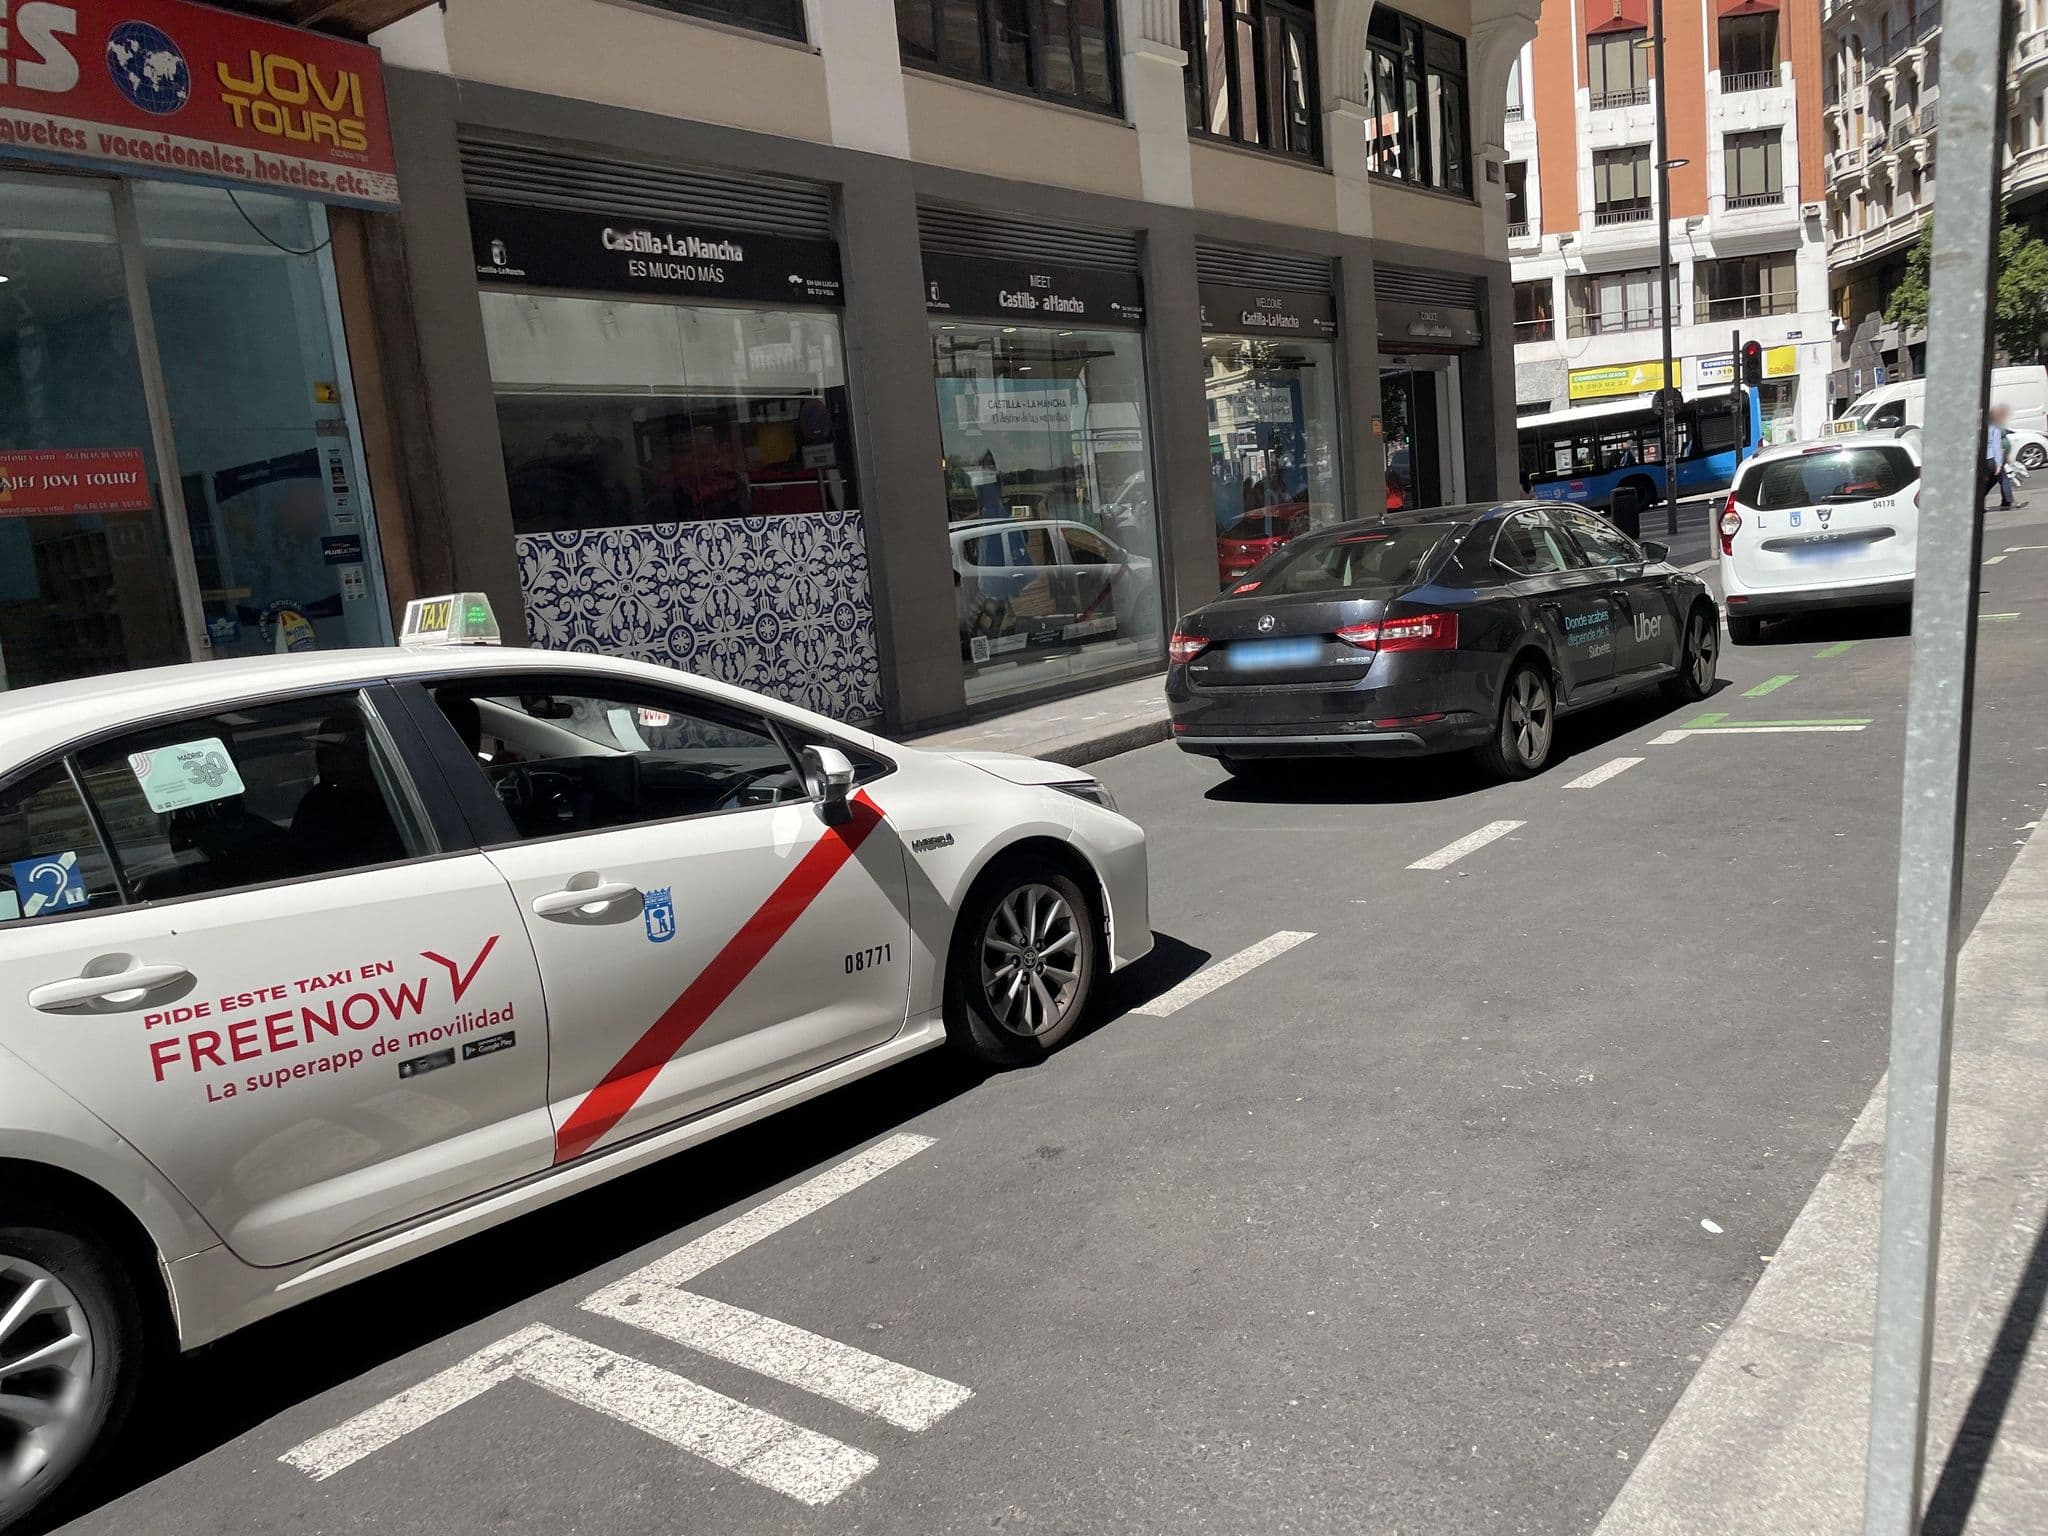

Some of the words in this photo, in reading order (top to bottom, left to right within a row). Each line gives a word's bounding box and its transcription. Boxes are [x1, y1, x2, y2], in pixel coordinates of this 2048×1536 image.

[216, 49, 364, 118] JOVI
[220, 93, 368, 152] TOURS
[629, 259, 646, 277] ES
[648, 262, 695, 281] MUCHO
[698, 264, 724, 283] MÁS
[988, 399, 1021, 409] CASTILLA
[1835, 422, 1855, 433] TAXI
[43, 473, 78, 490] JOVI
[85, 472, 138, 486] TOURS
[421, 602, 450, 631] TAXI
[1565, 613, 1587, 631] Donde
[1587, 609, 1610, 625] acabes
[1633, 612, 1662, 643] Uber
[177, 750, 204, 762] MADRID
[182, 751, 229, 788] 360
[845, 943, 891, 974] 08771
[144, 1002, 212, 1030] PIDE
[221, 985, 288, 1013] ESTE
[294, 969, 352, 995] TAXI
[360, 960, 394, 985] EN
[149, 977, 429, 1083] FREENOW
[206, 1081, 237, 1104] La
[246, 1049, 363, 1096] superapp
[372, 1035, 401, 1058] de
[408, 1001, 515, 1053] movilidad
